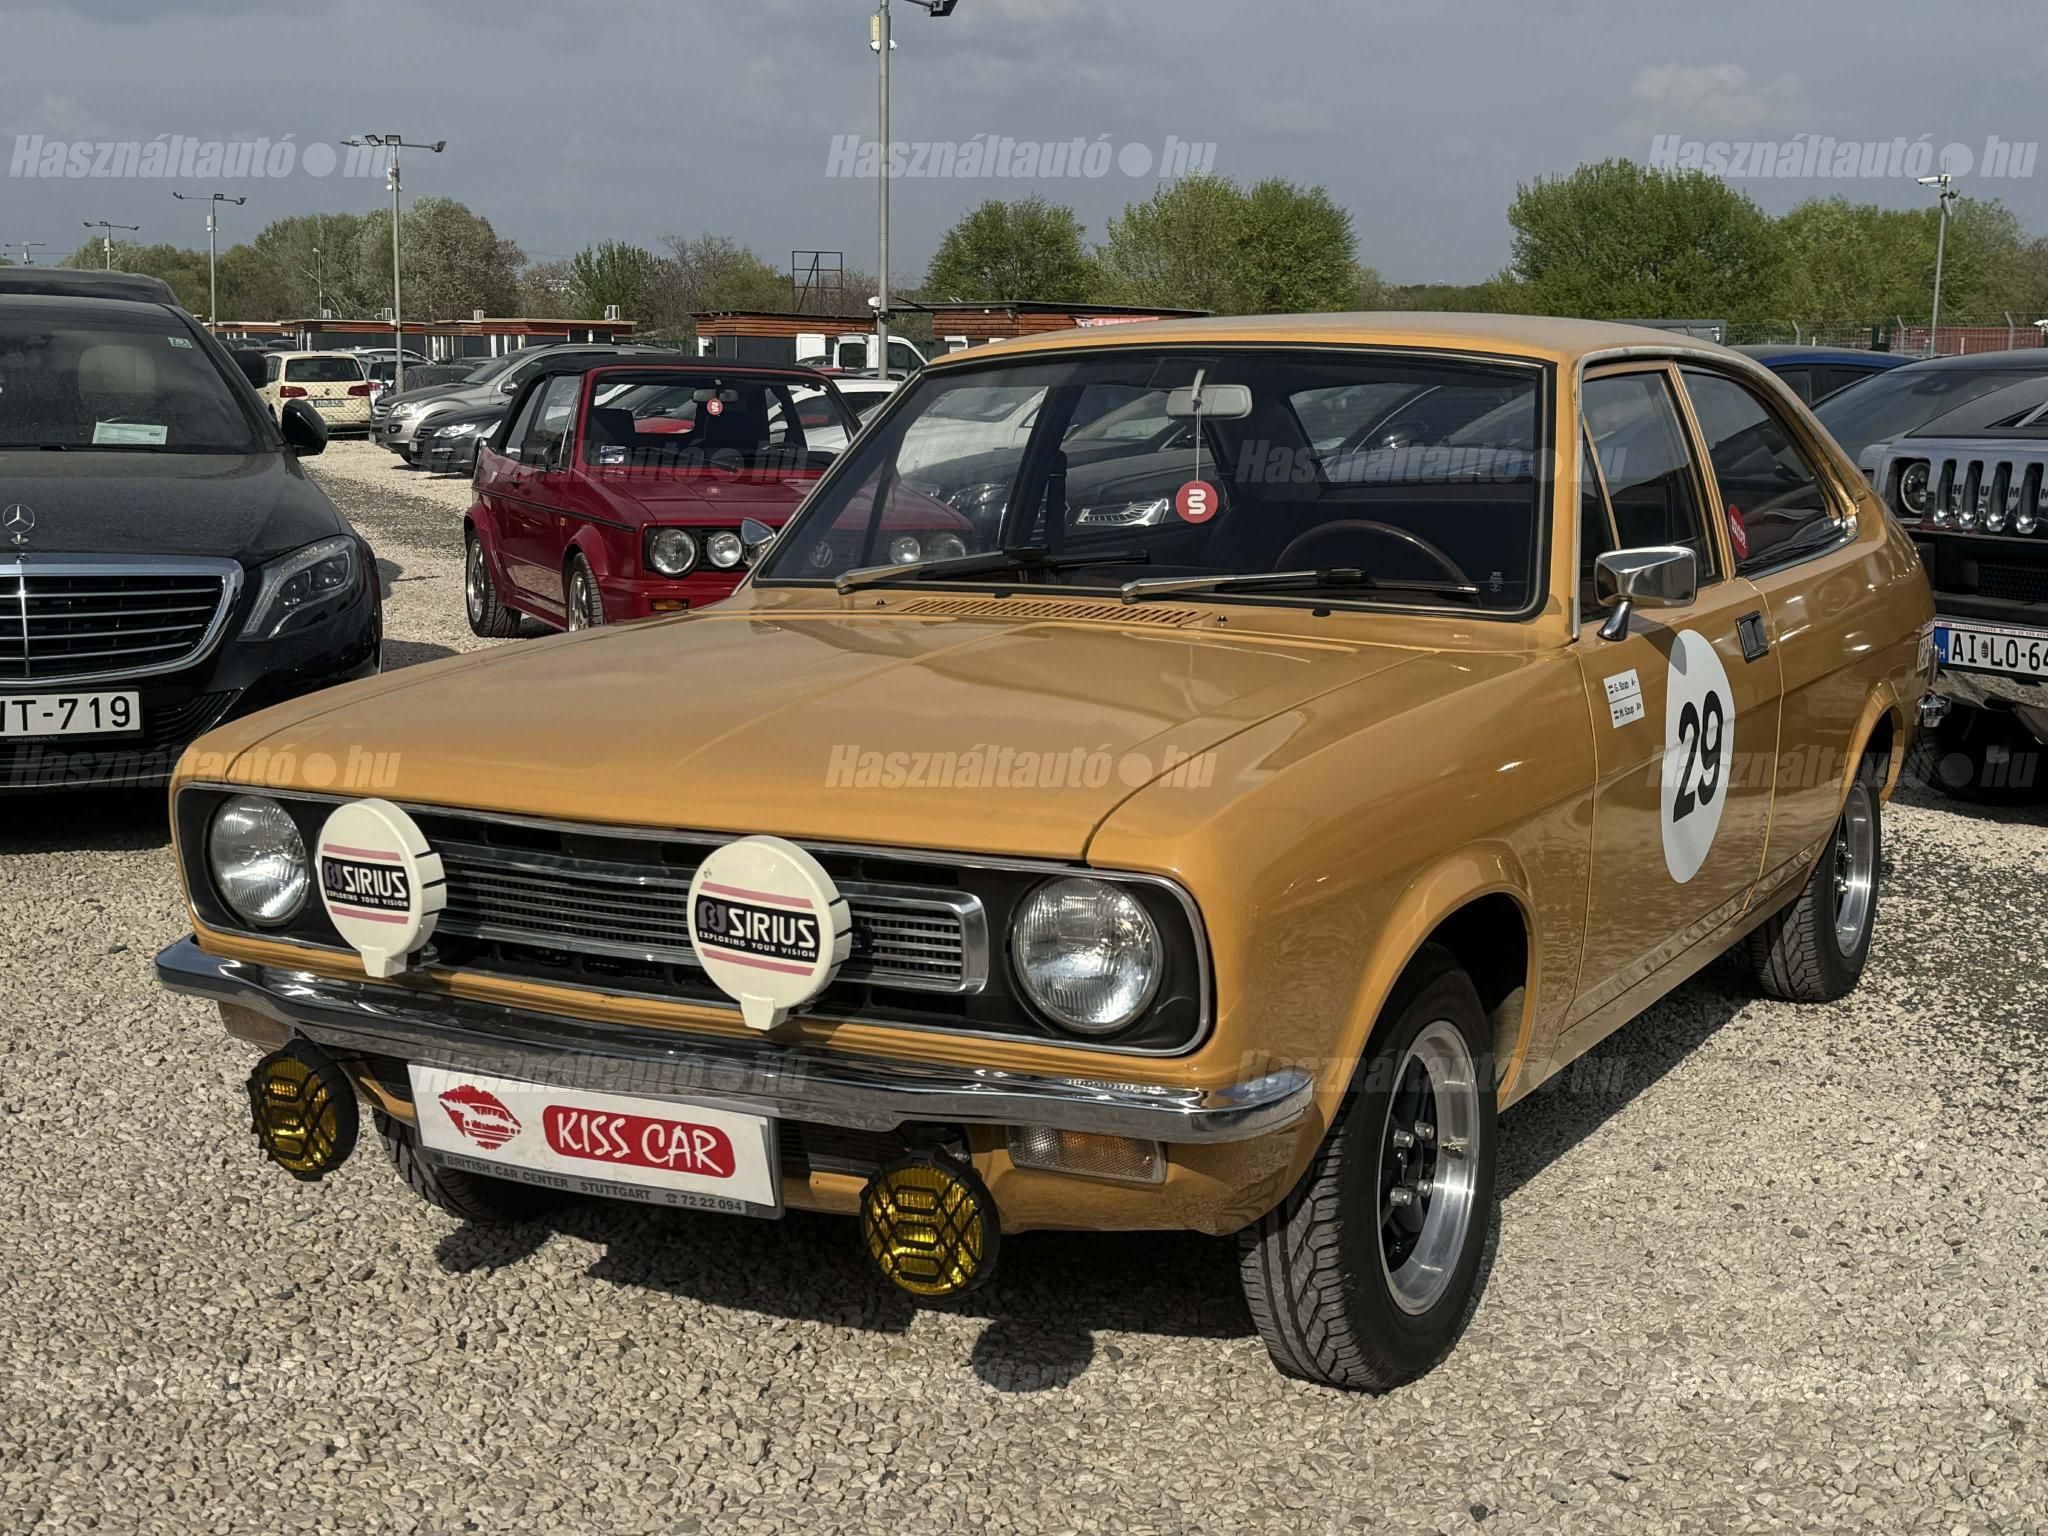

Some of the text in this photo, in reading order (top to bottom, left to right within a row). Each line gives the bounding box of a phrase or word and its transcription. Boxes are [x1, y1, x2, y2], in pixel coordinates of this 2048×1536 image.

[0, 695, 130, 732] T-719
[1673, 690, 1723, 823] 29
[342, 865, 407, 898] SIRIUS
[360, 896, 379, 905] YOUR
[381, 898, 408, 907] VISION
[698, 930, 816, 958] EXPLORING YOUR VISION
[728, 907, 815, 949] SIRIUS
[557, 1111, 724, 1174] KISS CAR
[447, 1155, 742, 1212] BRITISH CAR CENTER STUTTGART 72 22 094
